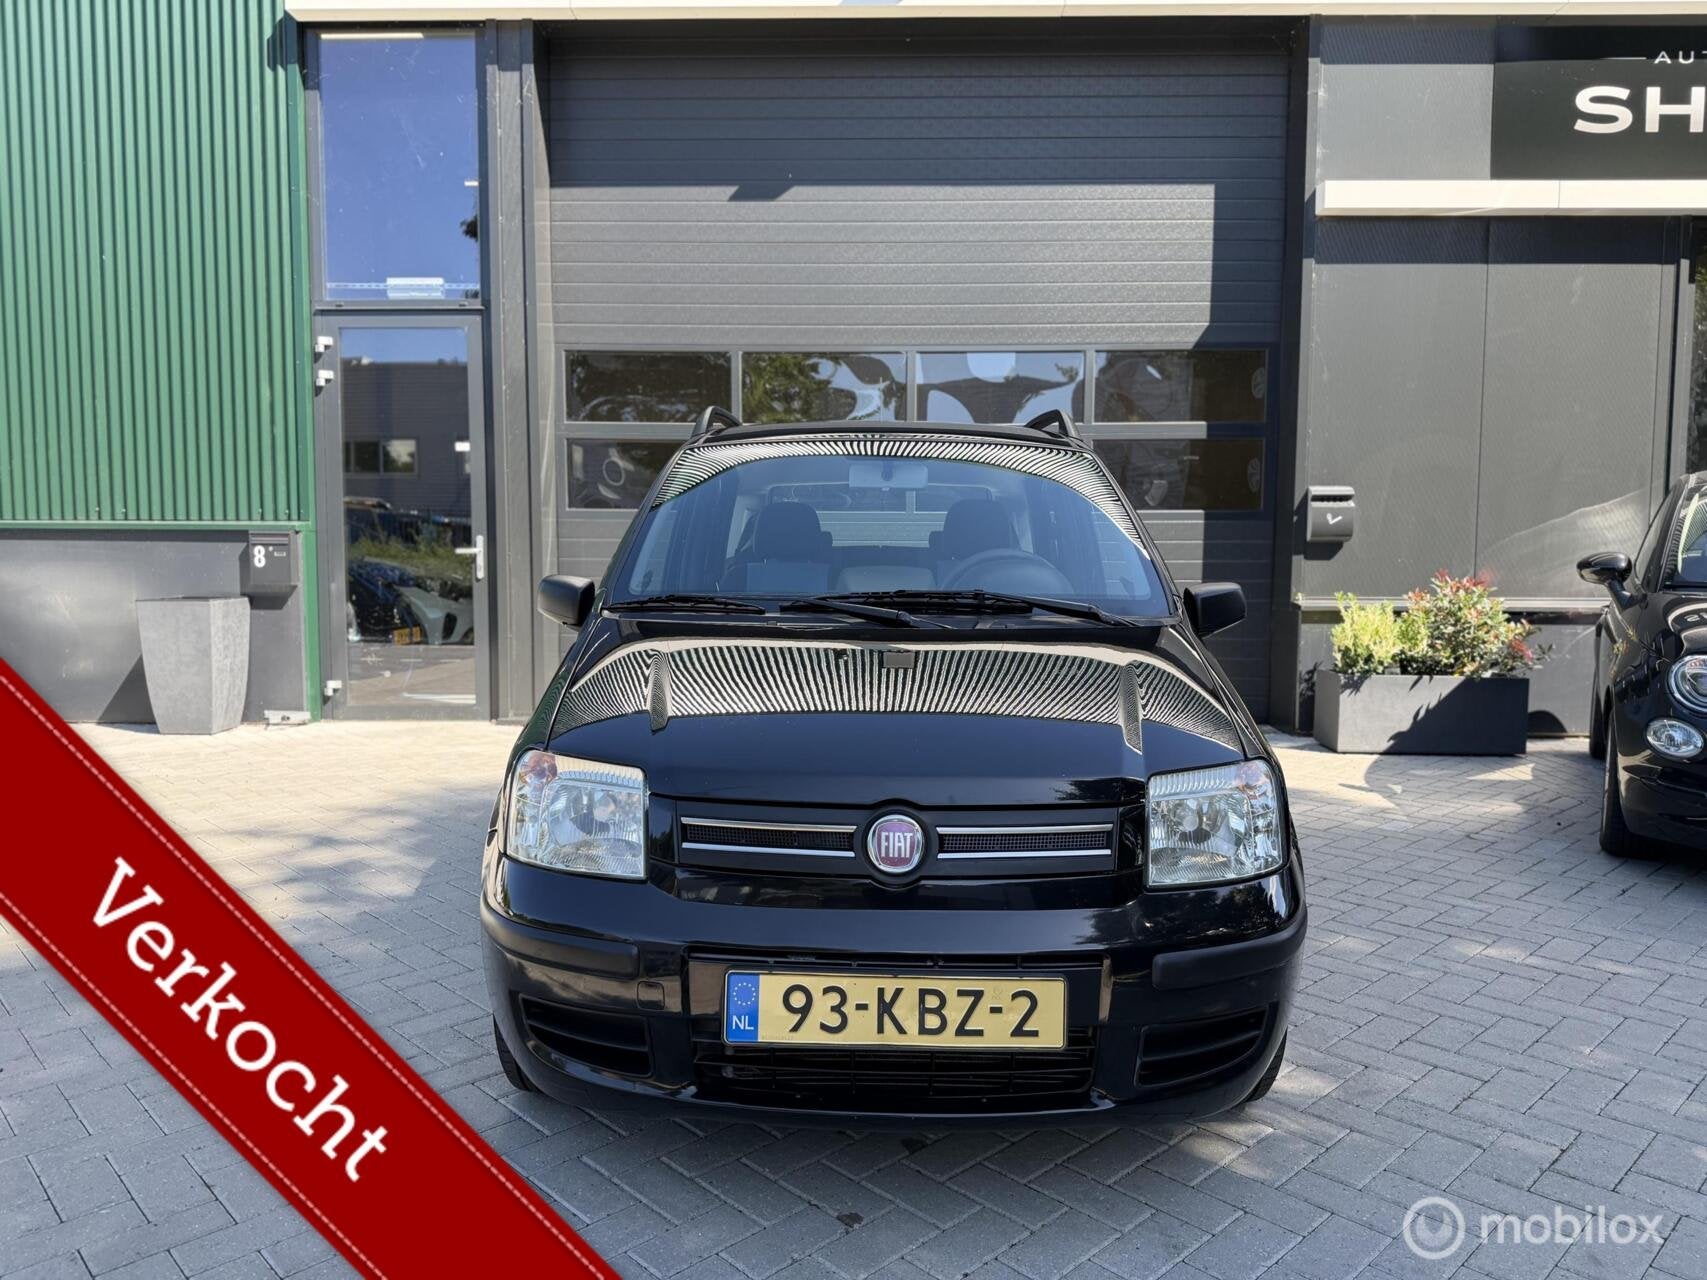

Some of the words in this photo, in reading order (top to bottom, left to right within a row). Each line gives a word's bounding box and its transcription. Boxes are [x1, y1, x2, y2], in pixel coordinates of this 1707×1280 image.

[1574, 85, 1706, 133] SH
[253, 545, 266, 568] 8
[881, 831, 913, 858] FIAT
[732, 1015, 754, 1031] NL
[782, 983, 1040, 1038] 93-KBZ-2
